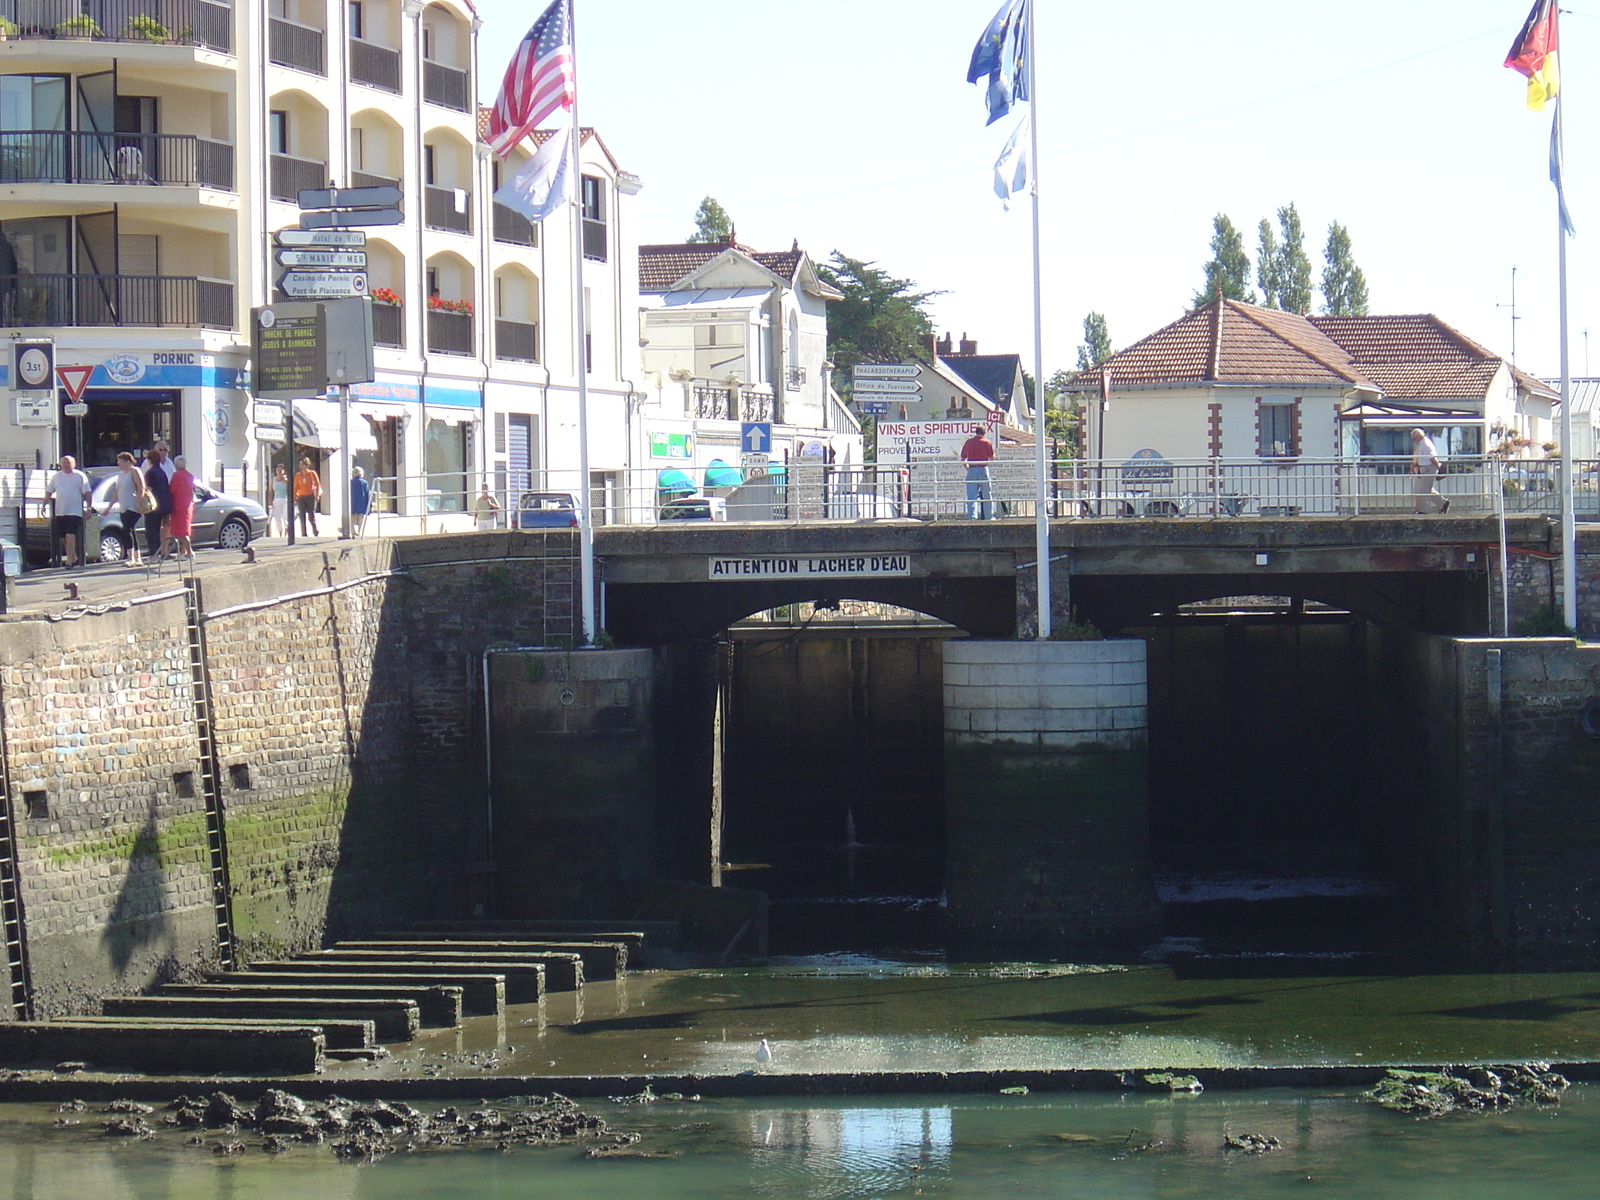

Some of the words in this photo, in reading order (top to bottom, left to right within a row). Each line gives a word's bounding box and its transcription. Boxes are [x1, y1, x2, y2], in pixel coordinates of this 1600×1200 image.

[346, 235, 363, 243] Ville
[309, 254, 335, 263] MARIE
[346, 255, 364, 263] MER
[292, 274, 316, 282] Casino
[317, 274, 326, 282] de
[292, 287, 307, 295] Port
[308, 287, 317, 295] de
[319, 287, 351, 295] Plaisance
[153, 353, 195, 365] PORNIC
[887, 383, 915, 391] Tourisme
[988, 412, 1001, 421] ICI
[878, 423, 906, 436] VINS
[909, 423, 921, 435] et
[893, 436, 927, 446] TOUTES
[713, 559, 799, 575] ATTENTION
[808, 558, 866, 573] LACHER
[870, 556, 907, 571] D'EAU
